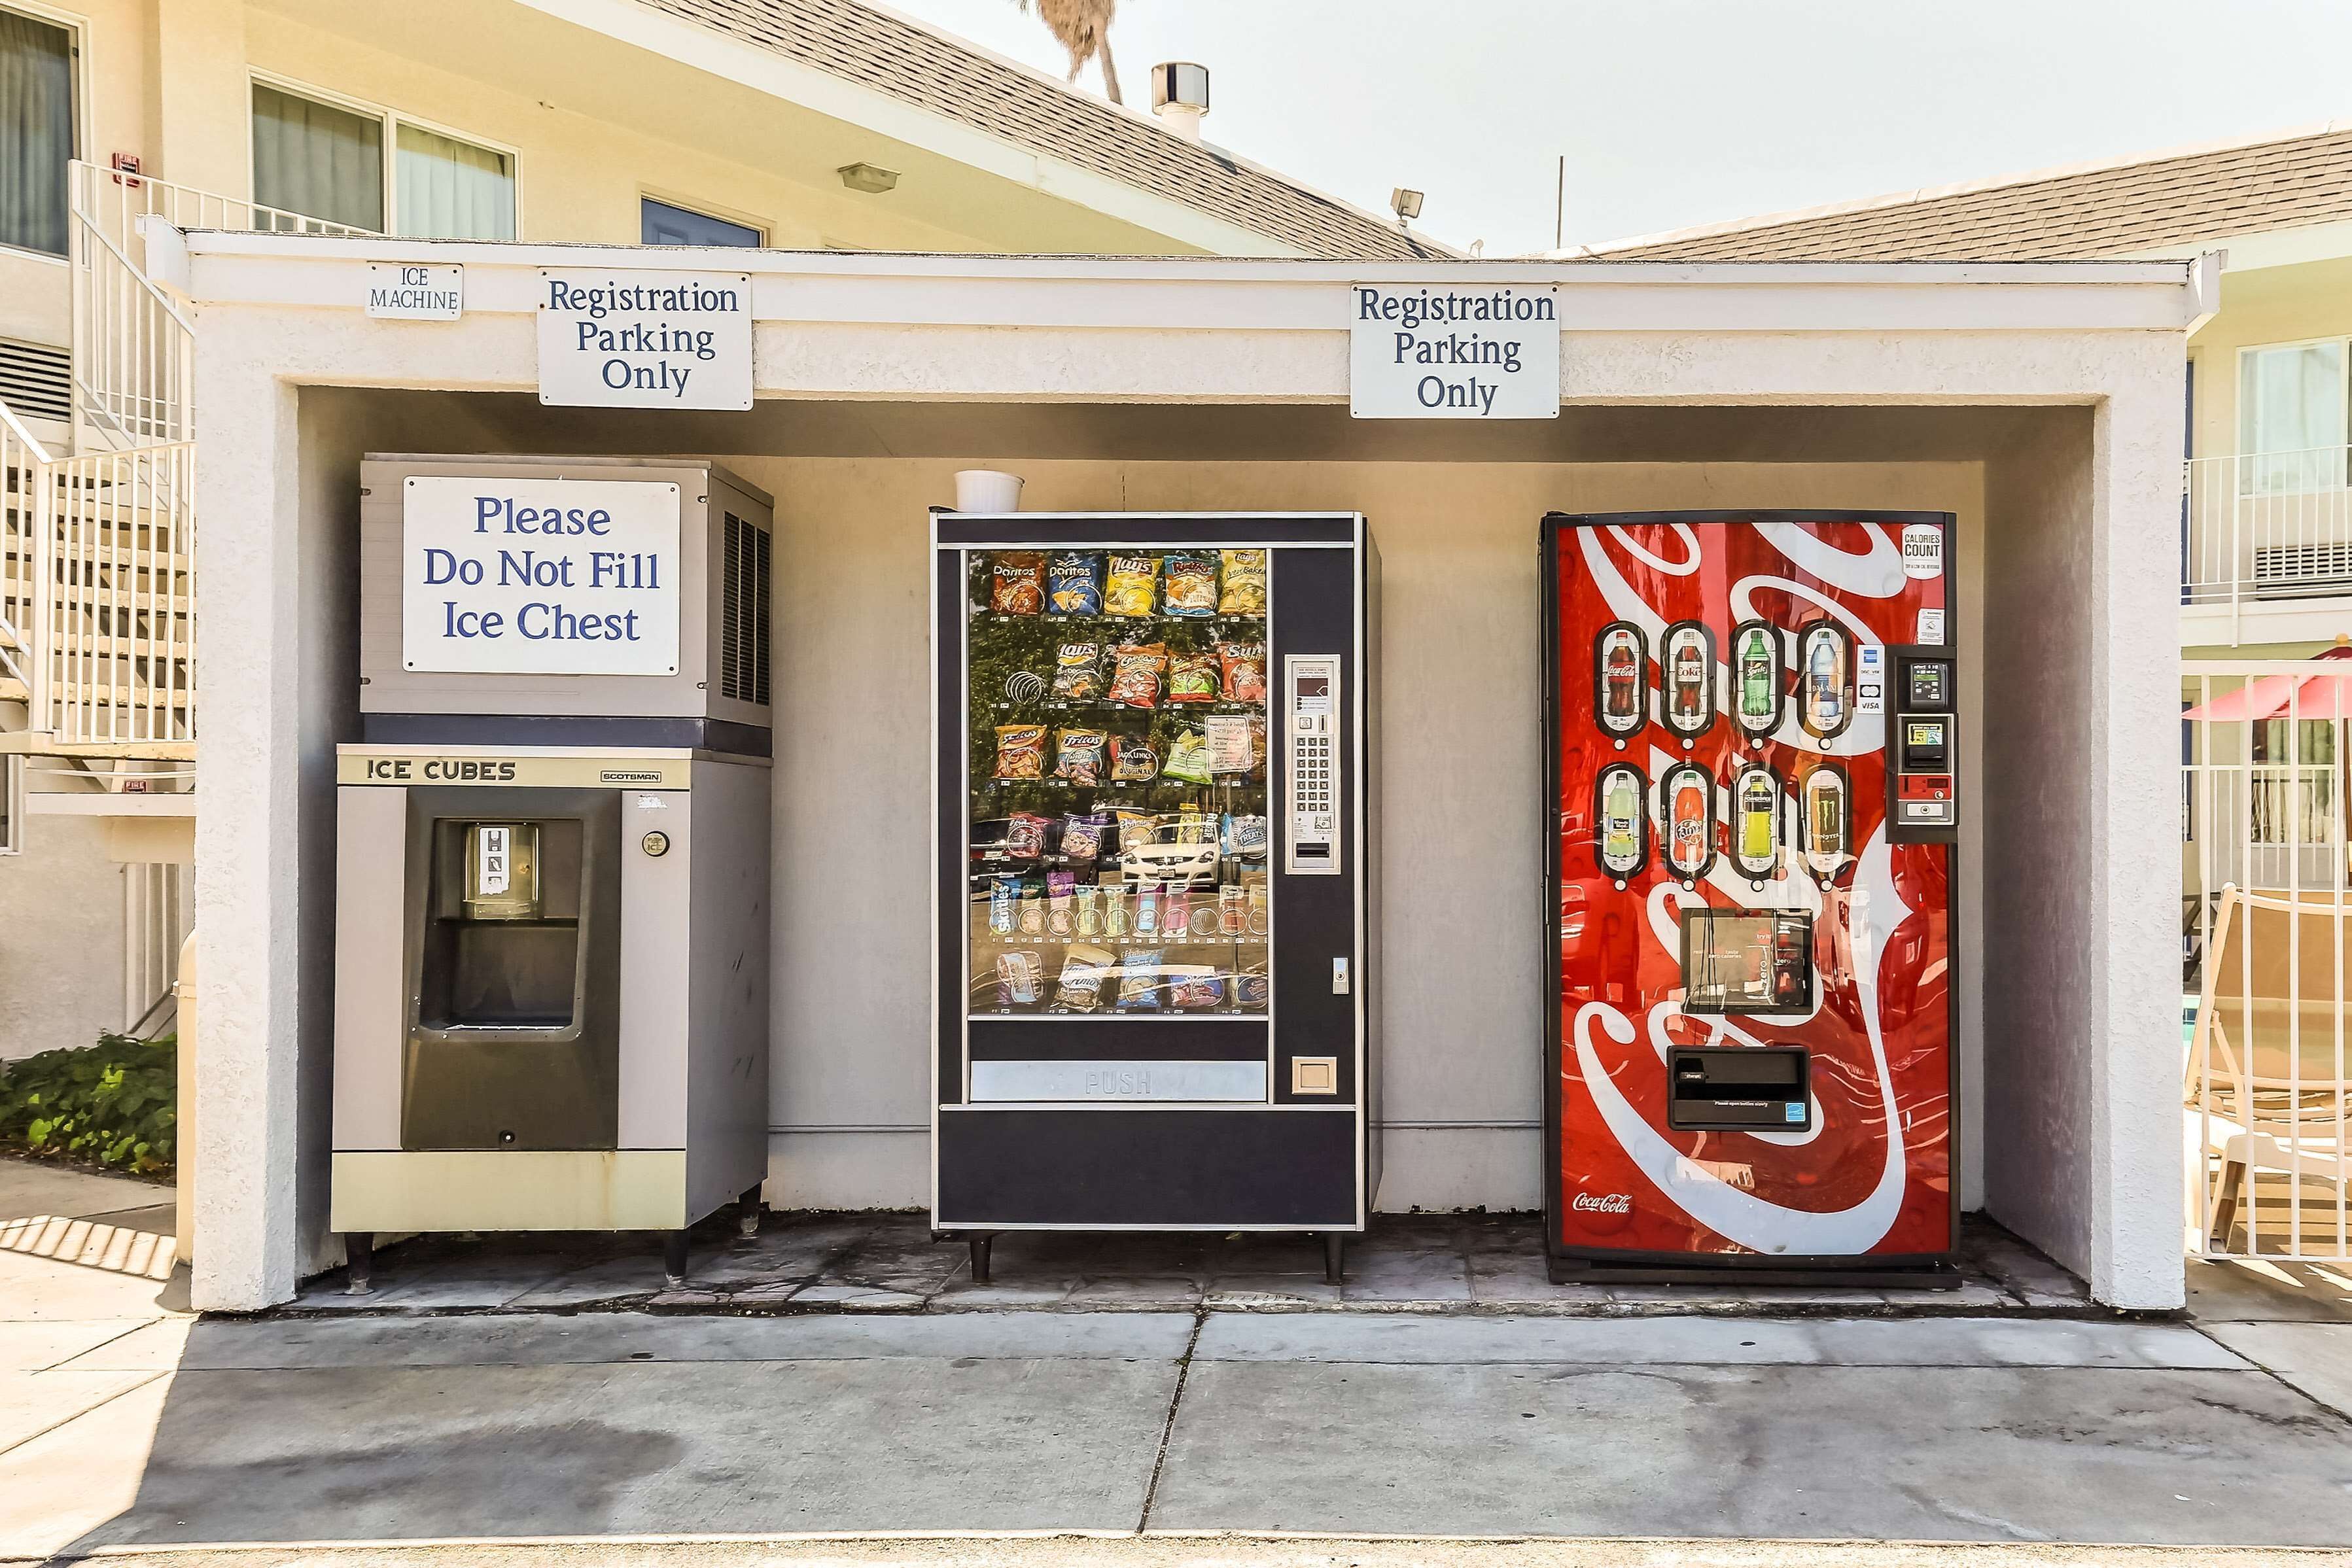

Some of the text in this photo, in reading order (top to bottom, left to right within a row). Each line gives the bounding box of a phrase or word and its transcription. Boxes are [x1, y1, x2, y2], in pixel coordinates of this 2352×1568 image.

[401, 268, 429, 286] ICE
[370, 288, 458, 309] MACHINE
[548, 280, 739, 318] Registration
[1358, 288, 1556, 329] Registration
[576, 321, 716, 360] Parking
[1394, 332, 1521, 373] Parking
[602, 359, 691, 397] Only
[1417, 375, 1498, 416] Only
[474, 497, 610, 535] Please
[1904, 534, 1940, 544] CALORIES
[1905, 544, 1940, 557] COUNT
[423, 548, 661, 589] Do Not Fill
[993, 565, 1036, 577] Doritos
[1049, 566, 1091, 577] Doritos
[443, 601, 641, 641] Ice Chest
[1064, 734, 1100, 746] Fritos
[367, 759, 516, 780] ICE CUBES
[1239, 831, 1264, 845] TREATS
[1085, 1071, 1151, 1094] PUSH
[1572, 1192, 1633, 1213] Coca-Cola
